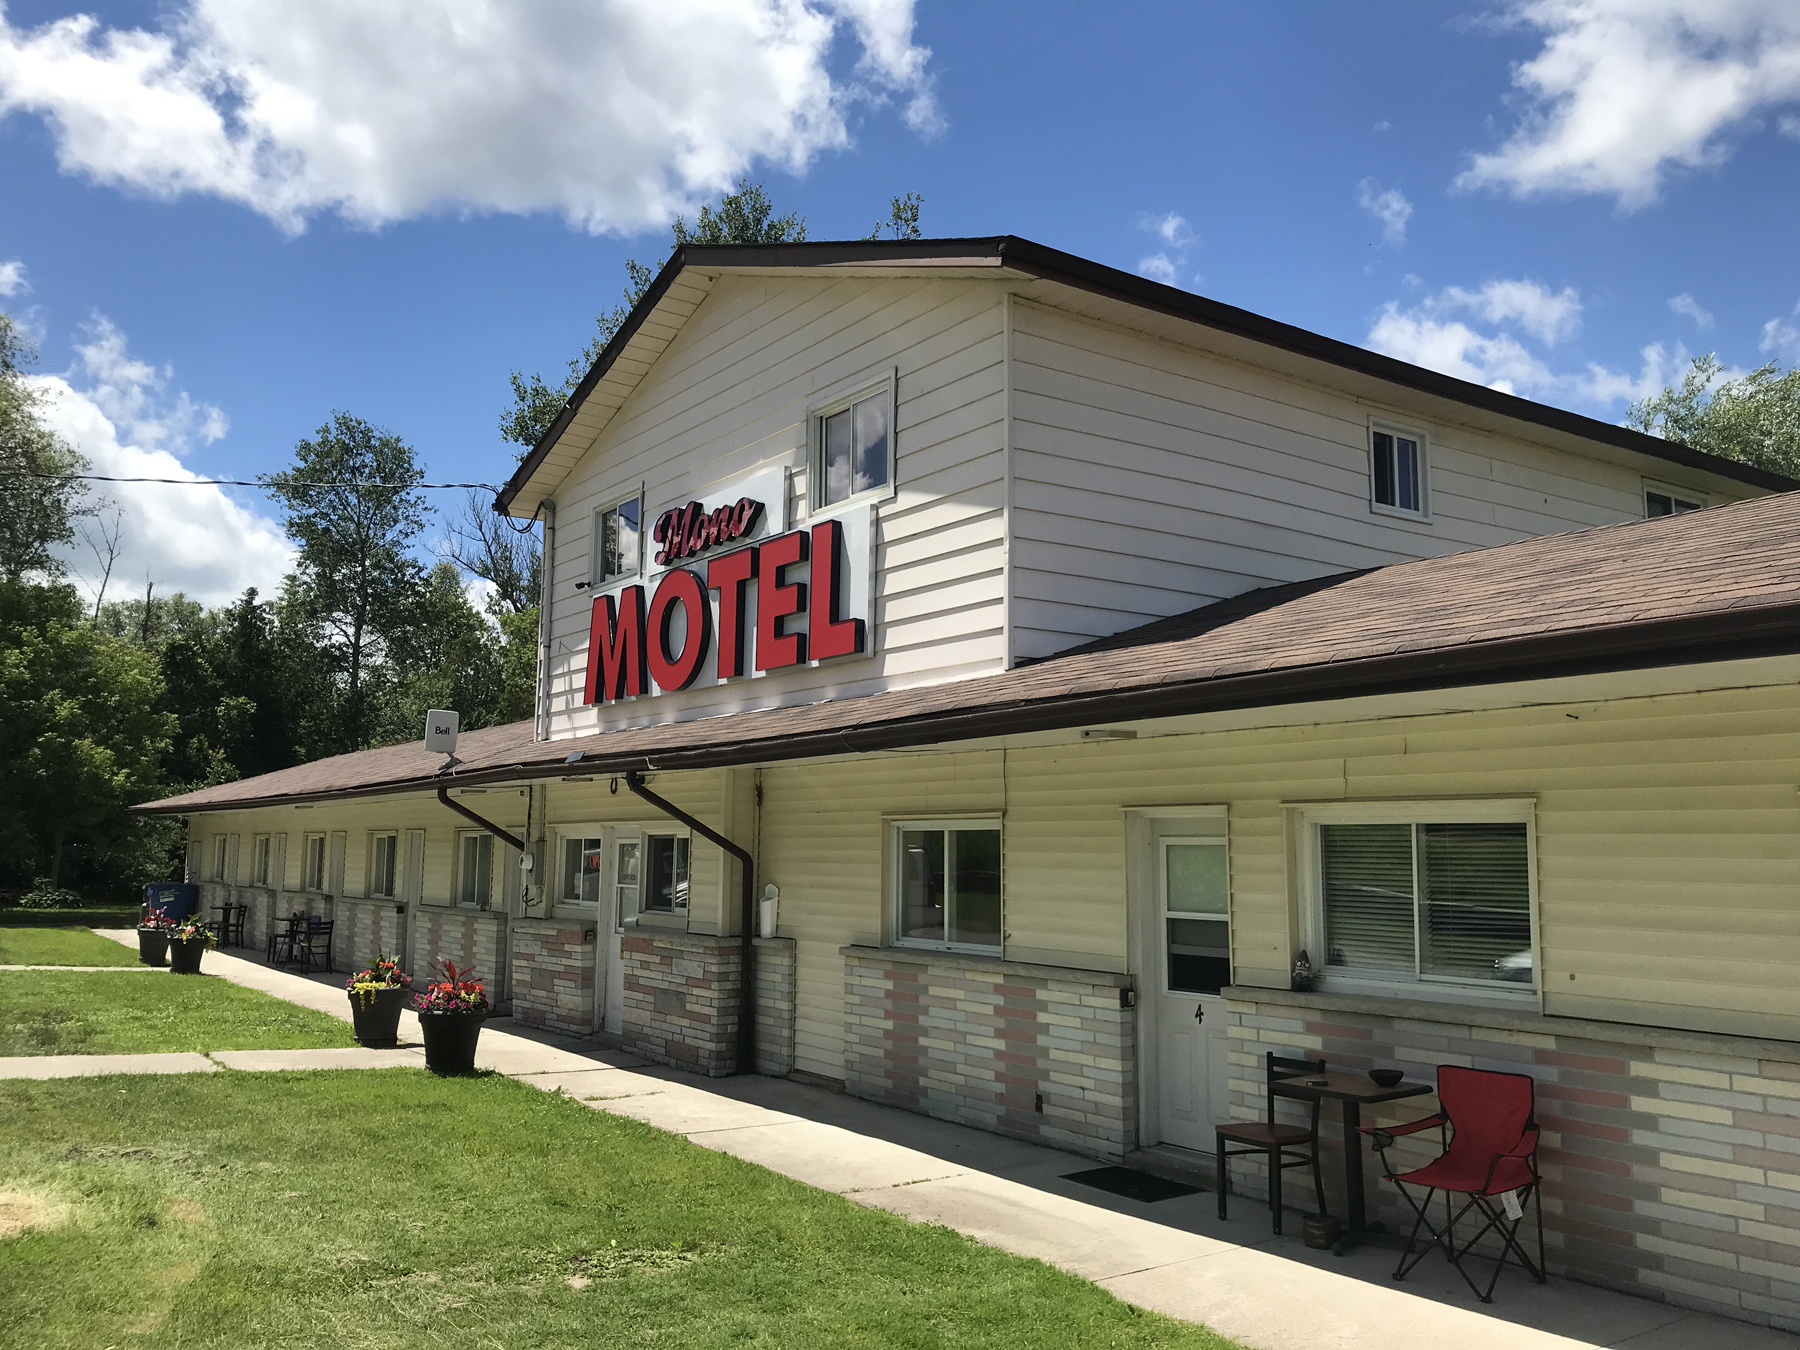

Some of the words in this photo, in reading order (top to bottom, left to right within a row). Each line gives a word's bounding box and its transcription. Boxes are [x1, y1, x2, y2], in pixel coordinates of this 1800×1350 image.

[654, 497, 764, 566] Mono
[583, 519, 864, 705] MOTEL
[435, 726, 450, 735] Bell
[588, 855, 600, 869] OPE
[1195, 1003, 1204, 1025] 4
